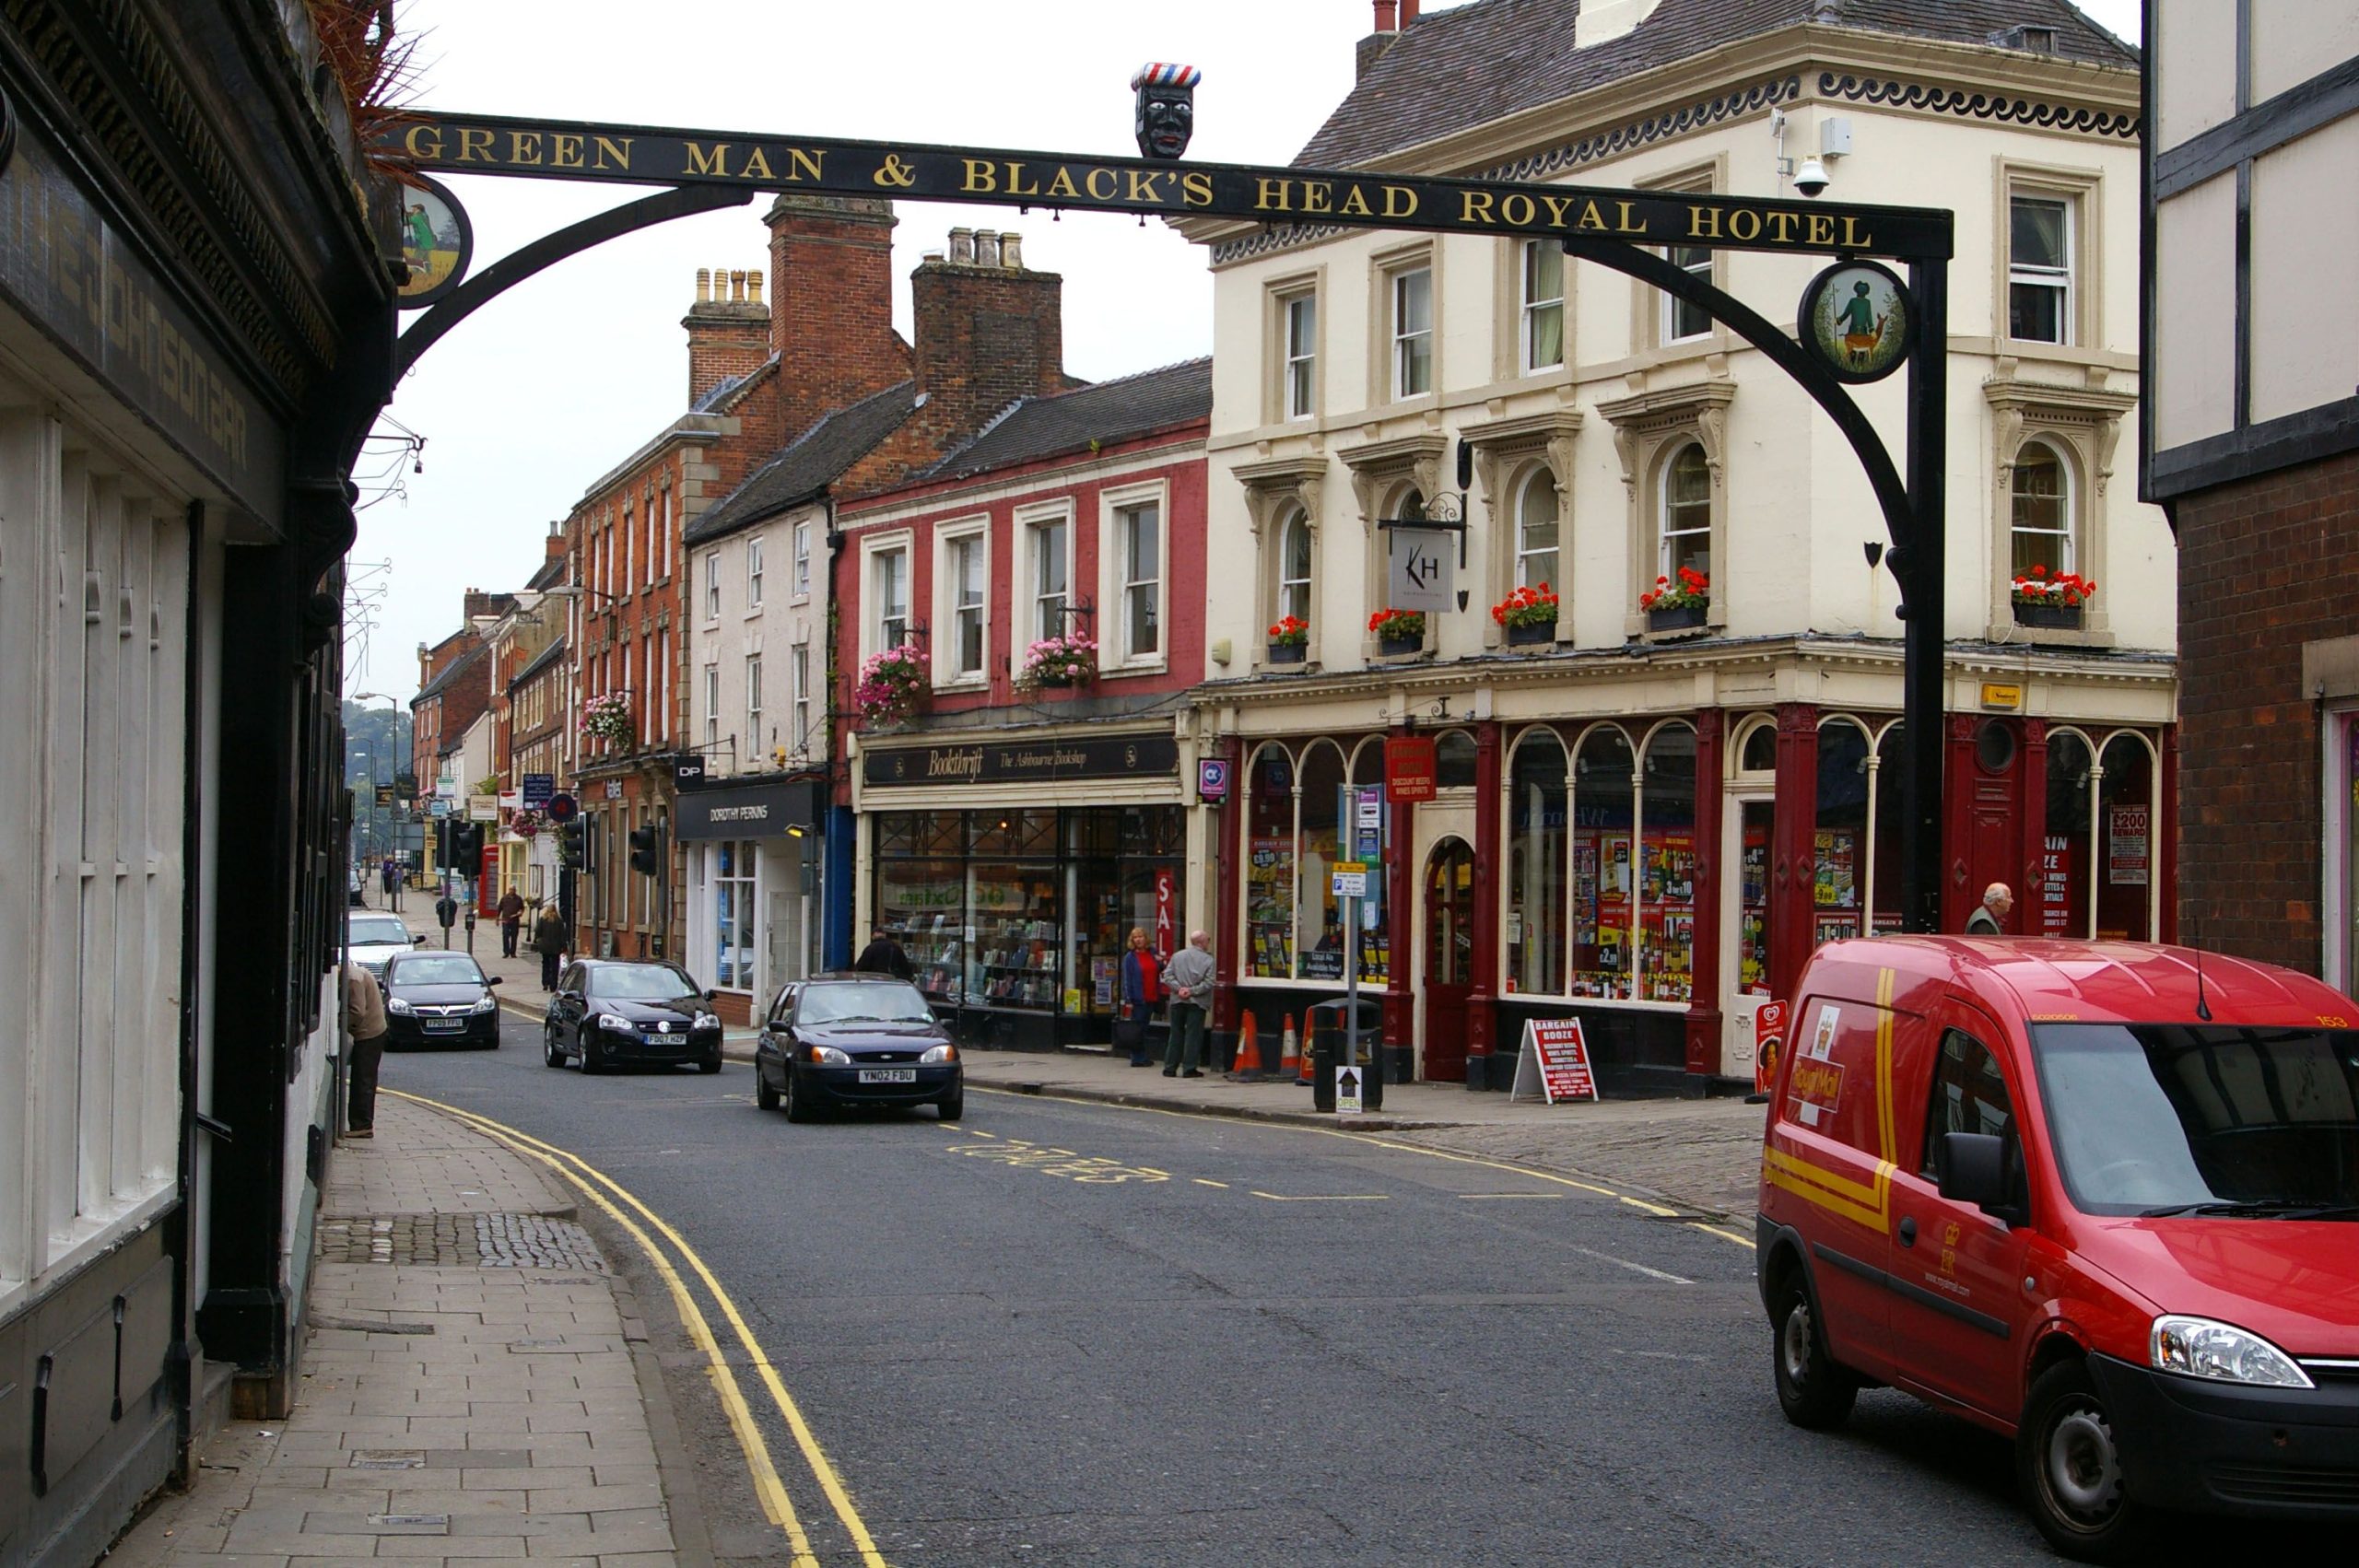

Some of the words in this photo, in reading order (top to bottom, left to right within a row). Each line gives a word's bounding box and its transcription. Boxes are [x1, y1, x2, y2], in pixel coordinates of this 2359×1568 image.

[405, 125, 634, 170] GREEN
[684, 142, 827, 181] MAN
[873, 153, 916, 187] &
[960, 158, 1214, 206] BLACK'S
[1256, 179, 1420, 218] HEAD
[1459, 190, 1648, 233] ROYAL
[1686, 205, 1873, 249] HOTEL
[1405, 542, 1438, 591] KH
[927, 746, 984, 783] Bookthrift
[1001, 753, 1013, 768] The
[1015, 750, 1053, 768] Ashbourne
[1054, 750, 1087, 768] Bookshop
[679, 766, 701, 777] DP
[710, 808, 738, 822] DOROTHY
[740, 805, 769, 820] PERKINS
[2113, 813, 2145, 827] £200
[2112, 828, 2145, 837] REWARD
[1535, 1021, 1576, 1030] BARGAIN
[2315, 1015, 2349, 1028] 153
[1543, 1031, 1573, 1039] BOOZE
[863, 1072, 890, 1082] YN02
[1337, 1097, 1360, 1107] OPEN
[1924, 1272, 1970, 1297] www.royalmail.com
